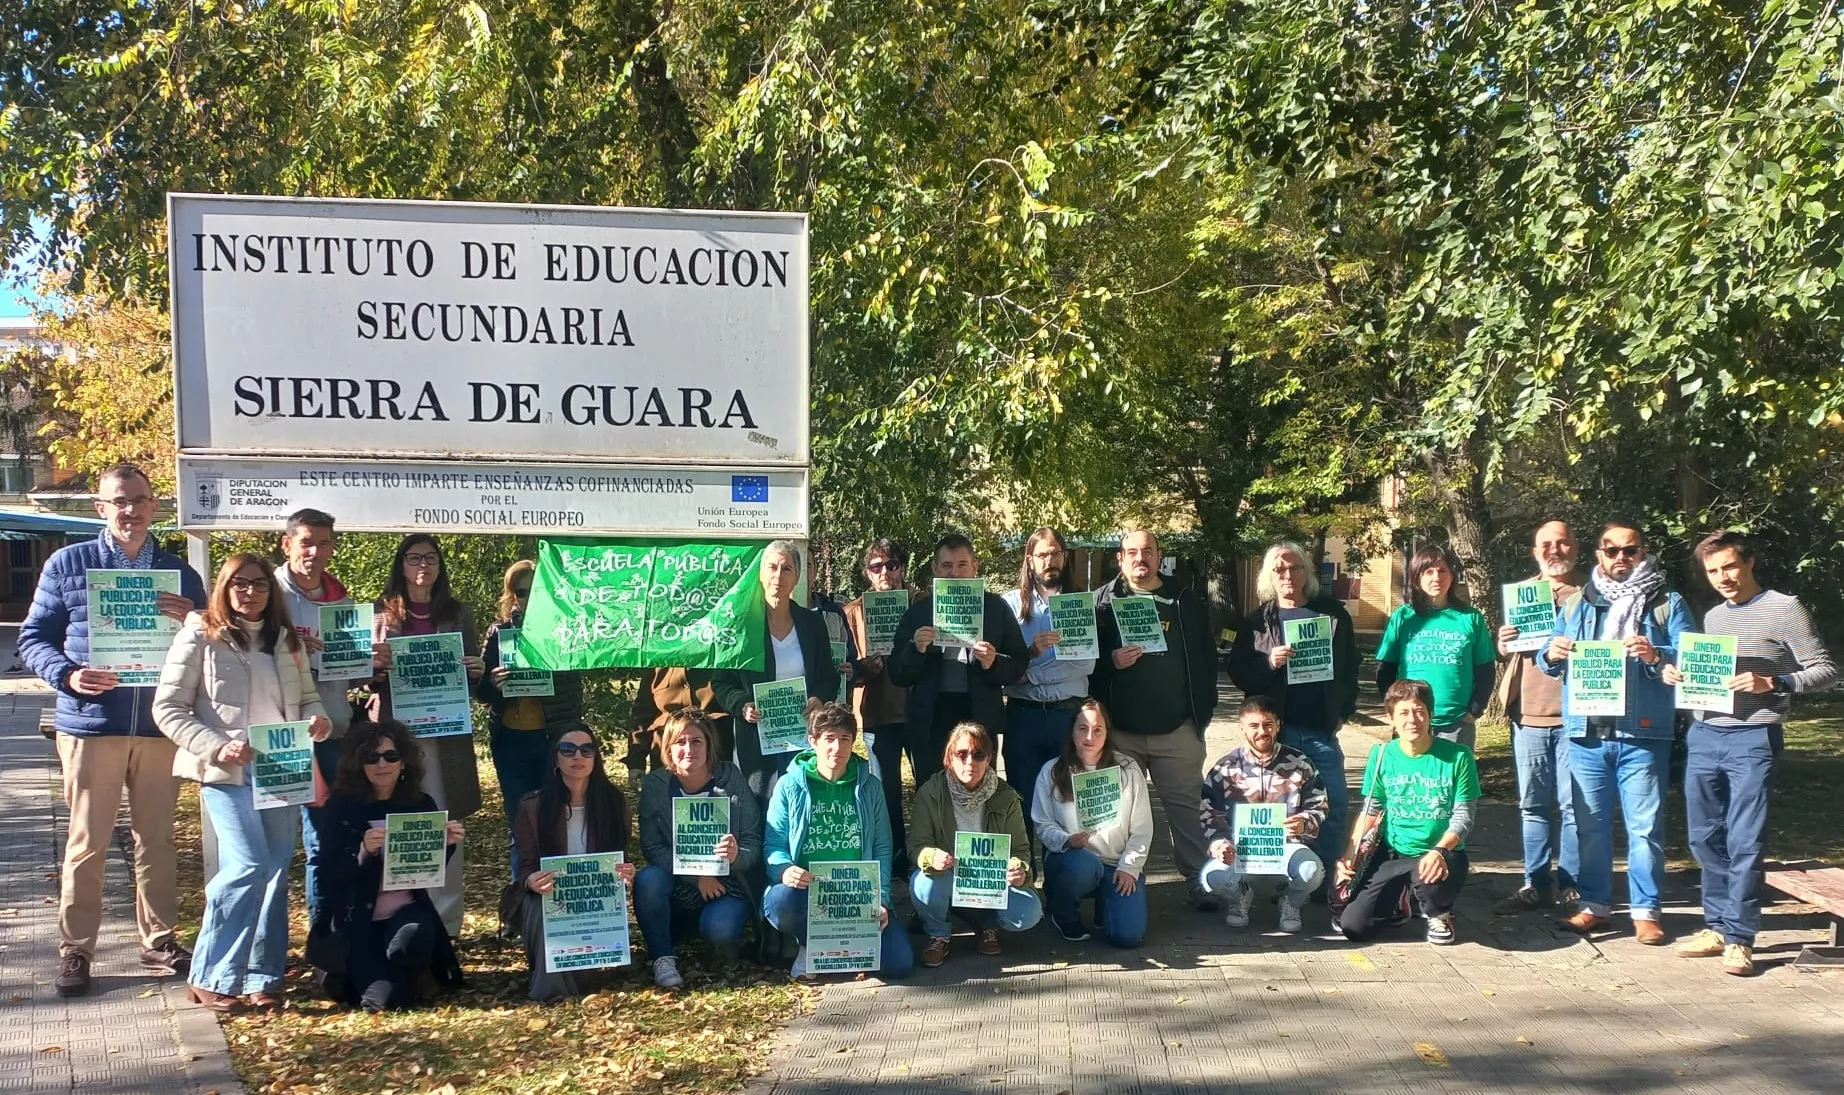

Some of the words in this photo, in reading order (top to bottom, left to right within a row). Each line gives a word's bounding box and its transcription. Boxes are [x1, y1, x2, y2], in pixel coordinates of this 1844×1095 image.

[192, 234, 434, 278] INSTITUTO
[461, 241, 516, 280] DE
[543, 244, 789, 288] EDUCACION
[357, 300, 635, 346] SECUNDARIA
[234, 375, 450, 421] SIERRA
[467, 382, 541, 423] DE
[561, 384, 758, 429] GUARA
[229, 480, 288, 488] DIPUTACION
[300, 471, 337, 487] ESTE
[342, 471, 400, 488] CENTRO
[405, 473, 469, 489] IMPARTE
[474, 471, 574, 491] ENSEÑANZAS
[578, 476, 694, 494] COFINANCIADAS
[230, 489, 272, 497] GENERAL
[230, 498, 243, 506] DE
[246, 498, 288, 506] ARAGON
[481, 495, 501, 505] POR
[505, 495, 518, 505] EL
[414, 508, 460, 524] FONDO
[464, 510, 517, 525] SOCIAL
[521, 510, 584, 527] EUROPEO
[697, 506, 725, 516] Unión
[729, 507, 768, 518] Europea
[697, 519, 726, 529] Fondo
[729, 519, 759, 529] Social
[763, 520, 802, 531] Europeo
[561, 552, 653, 572] ESCUELA
[116, 577, 152, 588] DINERO
[948, 586, 971, 594] DINERO
[1518, 586, 1538, 604] NO!
[578, 586, 615, 606] DE
[875, 597, 896, 606] DINERO
[965, 596, 982, 604] PARA
[937, 605, 944, 613] LA
[1061, 599, 1083, 609] DINERO
[1516, 603, 1552, 614] CONCIERTO
[100, 604, 112, 616] LA
[1078, 608, 1093, 617] PARA
[335, 610, 358, 629] NO!
[867, 617, 873, 625] LA
[1053, 620, 1061, 628] LA
[1509, 614, 1543, 625] EDUCATIVO
[1545, 612, 1554, 620] EN
[560, 618, 634, 647] PARA
[1298, 622, 1319, 639] NO!
[1519, 622, 1555, 633] CHILLERATO
[409, 641, 440, 653] DINERO
[1297, 639, 1330, 649] CONCIERTO
[1694, 642, 1720, 653] DINERO
[433, 651, 455, 663] PARA
[1584, 649, 1610, 657] DINERO
[1289, 656, 1331, 668] BACHILLERATO
[1603, 659, 1622, 668] PARA
[1713, 655, 1732, 665] PARA
[399, 666, 409, 677] LA
[1681, 663, 1688, 672] LA
[1573, 670, 1581, 679] LA
[769, 687, 793, 698] DINERO
[268, 728, 296, 749] NO!
[1086, 776, 1109, 788] DINERO
[1104, 783, 1120, 793] PARA
[1078, 800, 1086, 809] LA
[690, 803, 714, 821] NO!
[1250, 808, 1272, 825] NO!
[403, 820, 432, 831] DINERO
[677, 824, 686, 833] AL
[687, 824, 727, 833] CONCIERTO
[424, 830, 443, 840] PARA
[1239, 828, 1246, 836] AL
[1248, 828, 1283, 836] CONCIERTO
[677, 835, 716, 844] EDUCATIVO
[1239, 837, 1274, 846] EDUCATIVO
[389, 843, 398, 853] LA
[971, 838, 995, 856] NO!
[1237, 847, 1283, 856] BACHILLERATO
[566, 860, 599, 874] DINERO
[959, 858, 967, 867] AL
[968, 858, 1006, 869] CONCIERTO
[592, 872, 615, 885] PARA
[832, 868, 859, 879] DINERO
[958, 868, 996, 879] EDUCATIVO
[997, 870, 1006, 879] EN
[853, 880, 872, 891] PARA
[956, 878, 1006, 890] BACHILLERATO
[553, 889, 564, 902] LA
[818, 894, 827, 905] LA
